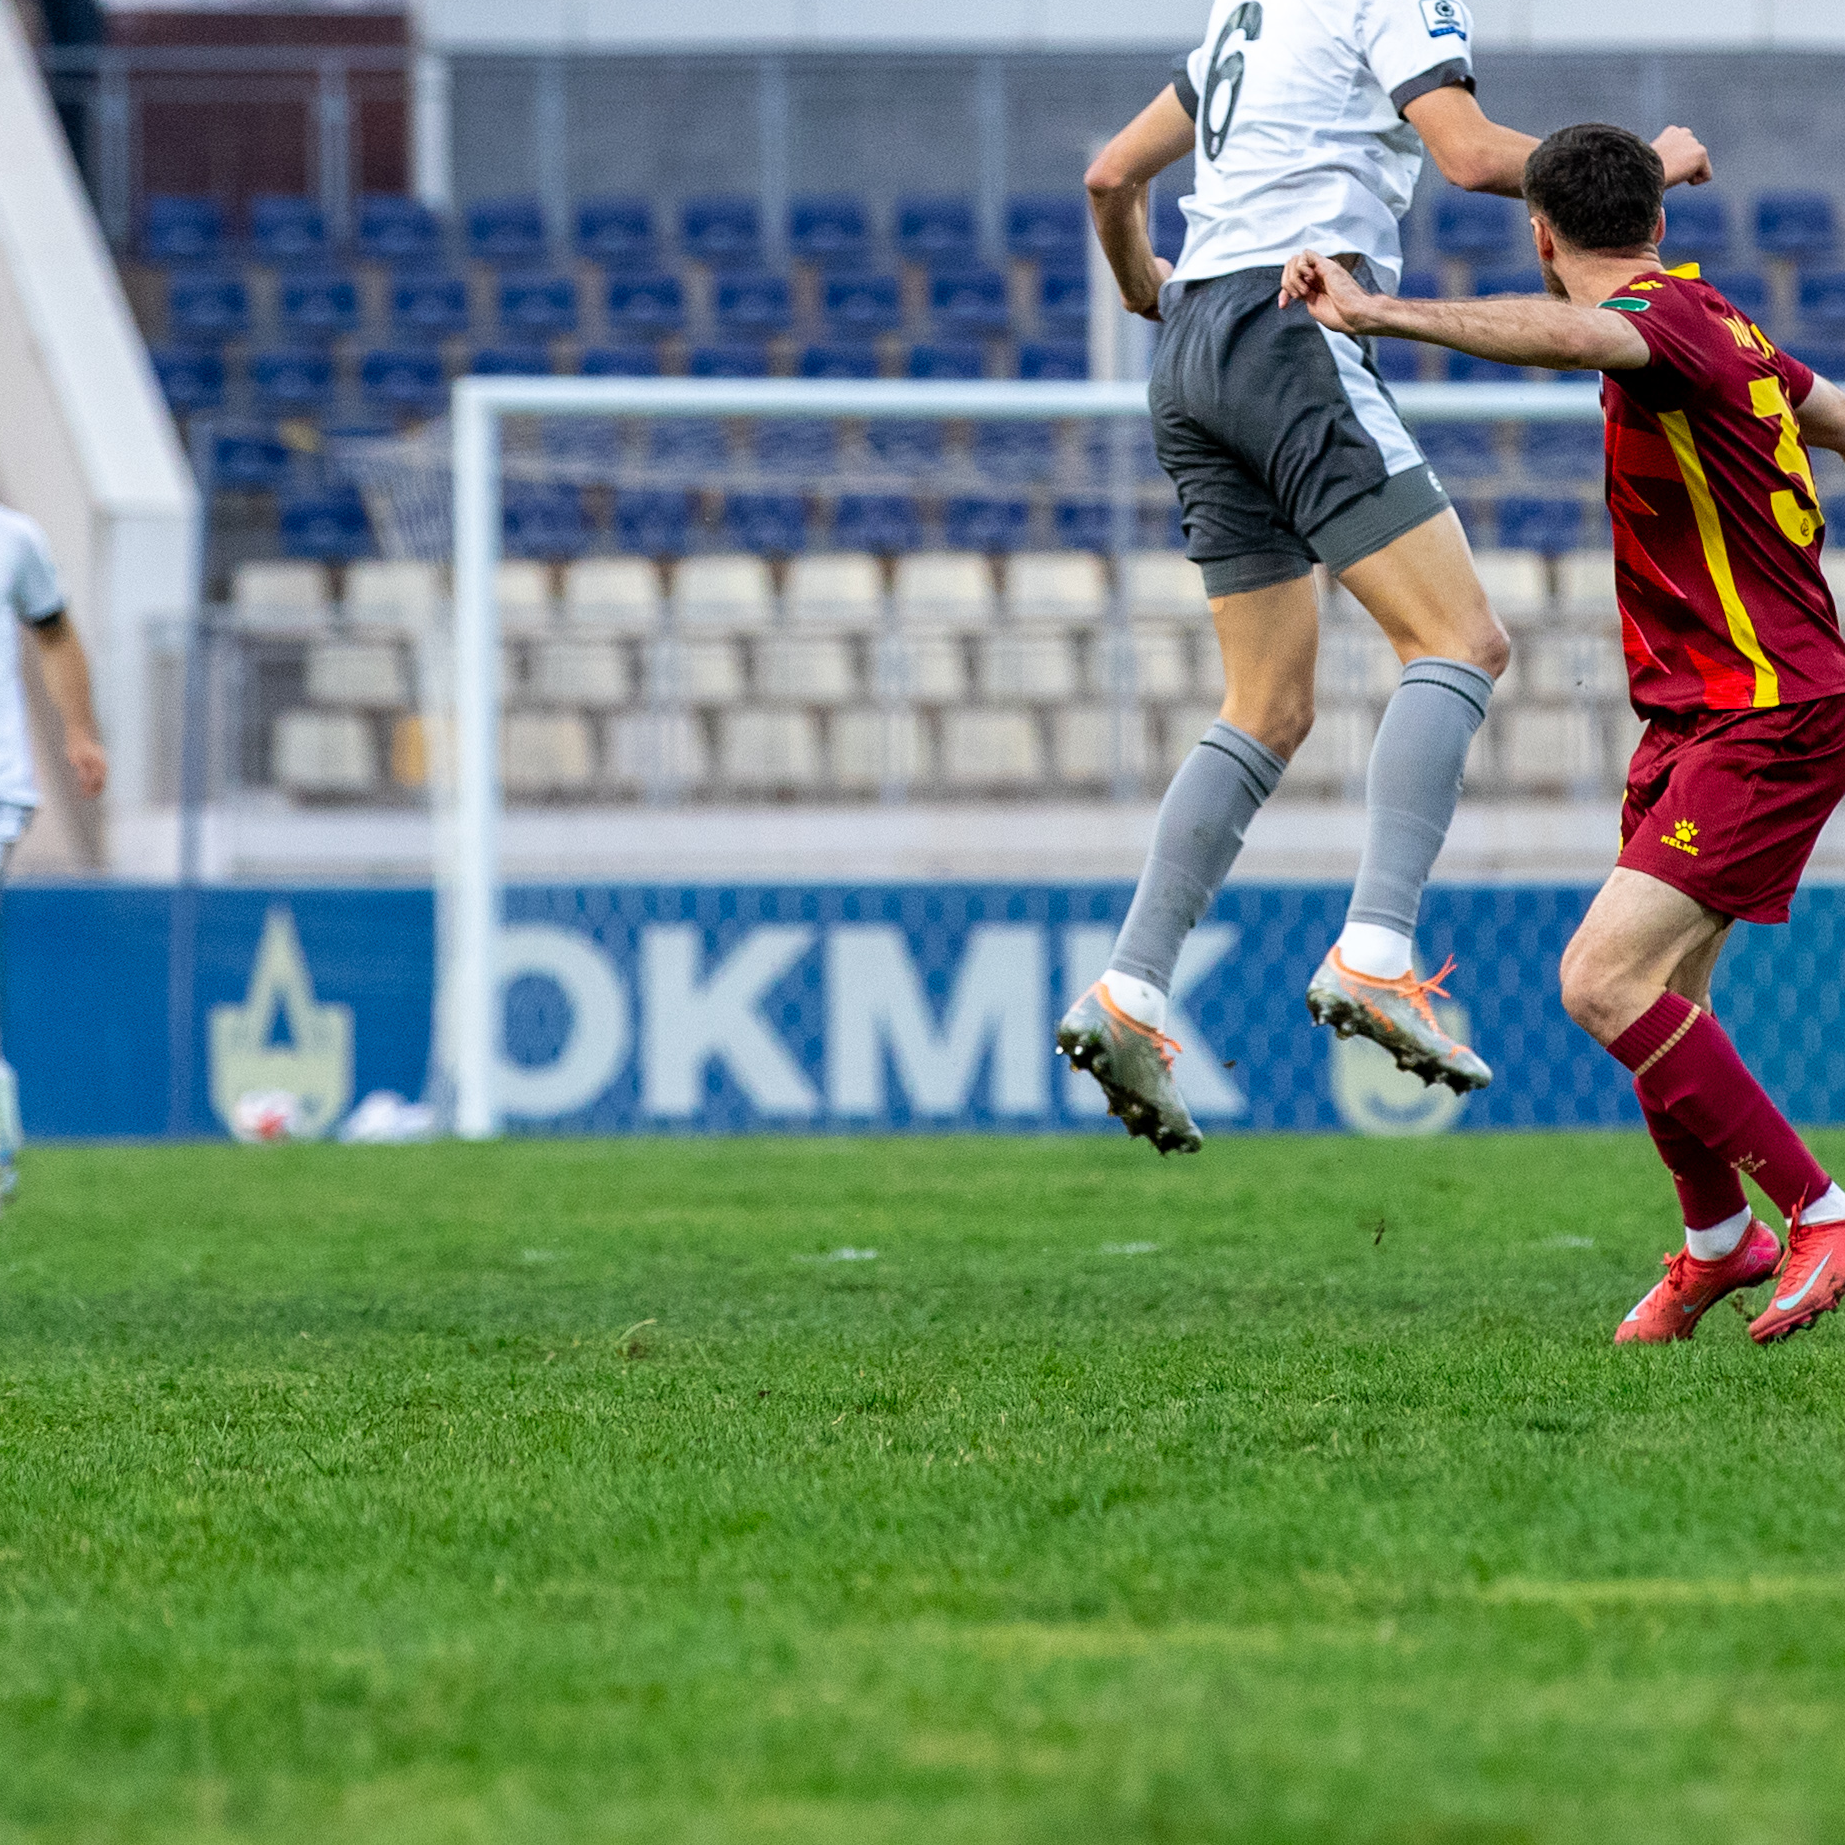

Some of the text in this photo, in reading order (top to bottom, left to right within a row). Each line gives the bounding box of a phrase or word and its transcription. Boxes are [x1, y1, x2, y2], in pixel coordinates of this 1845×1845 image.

[1202, 1, 1263, 162] 6
[1748, 375, 1825, 547] 3
[1660, 834, 1700, 856] KELME
[491, 919, 1247, 1123] OKMK
